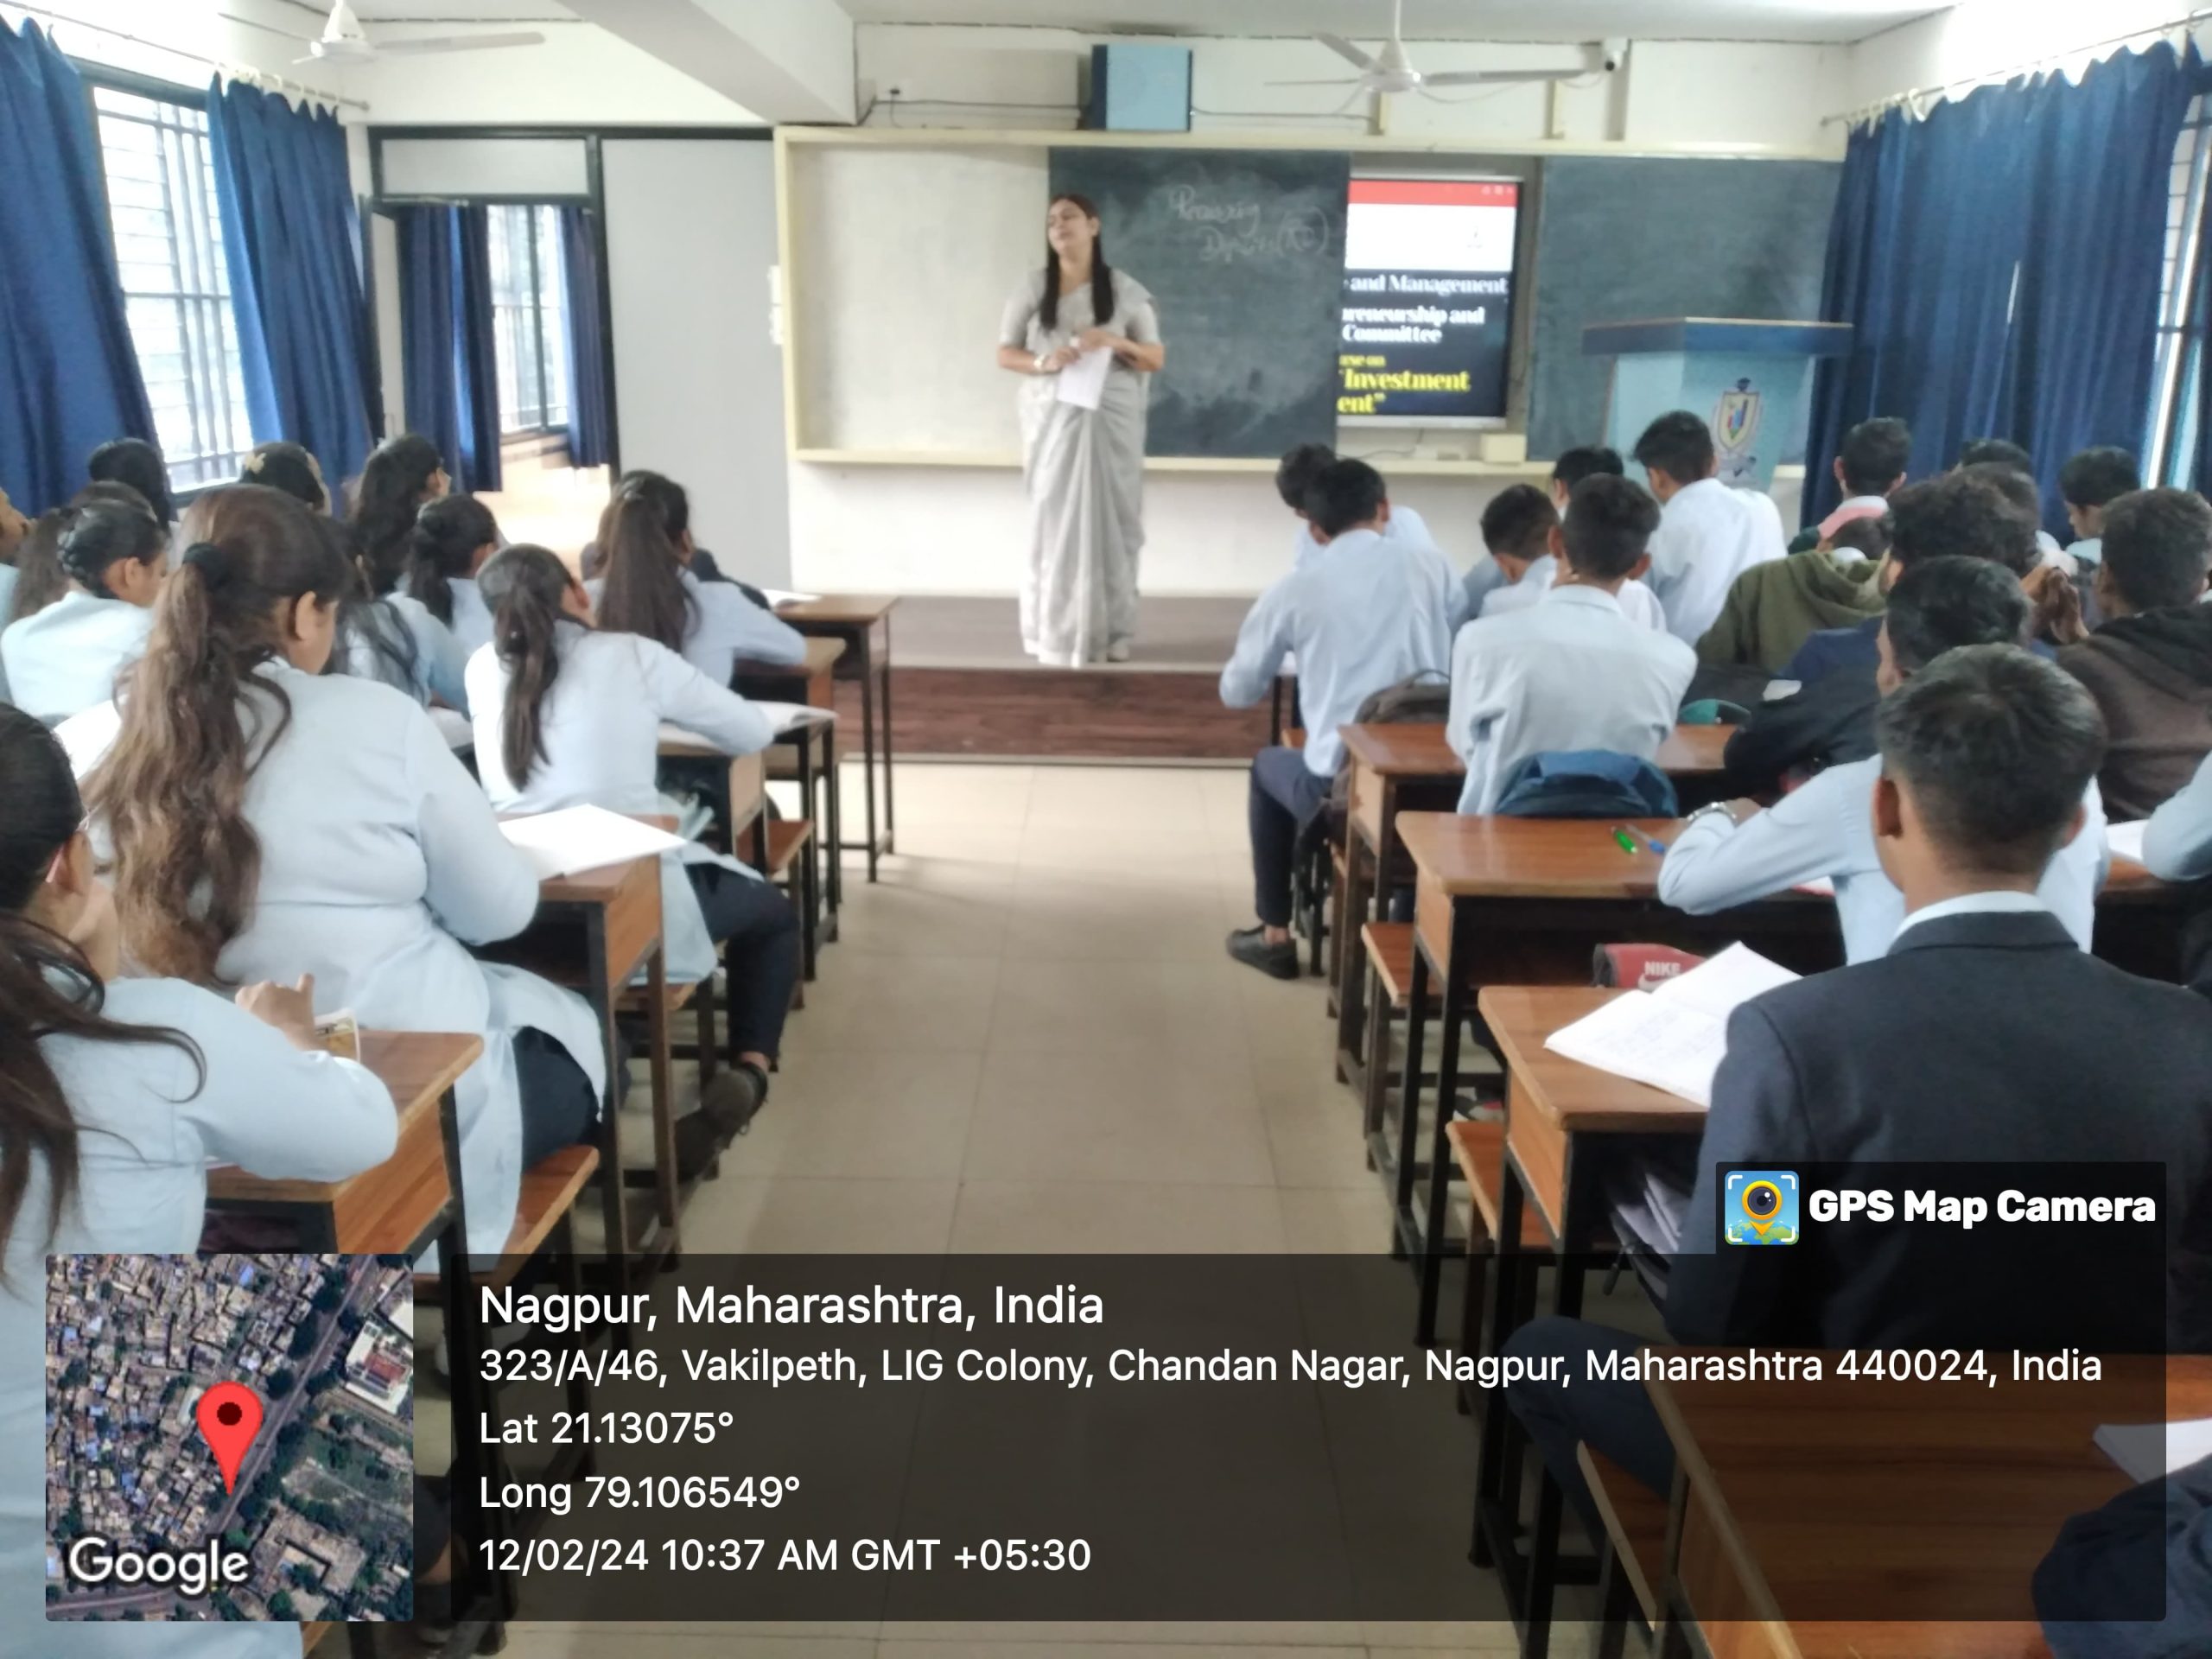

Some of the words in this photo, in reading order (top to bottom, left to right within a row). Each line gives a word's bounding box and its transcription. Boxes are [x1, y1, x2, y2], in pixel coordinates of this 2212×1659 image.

[1350, 274, 1385, 292] and
[1388, 275, 1509, 296] Management
[1342, 305, 1448, 327] reneurship
[1449, 306, 1485, 324] and
[1342, 324, 1443, 343] Committee
[1644, 961, 1681, 976] NIKE
